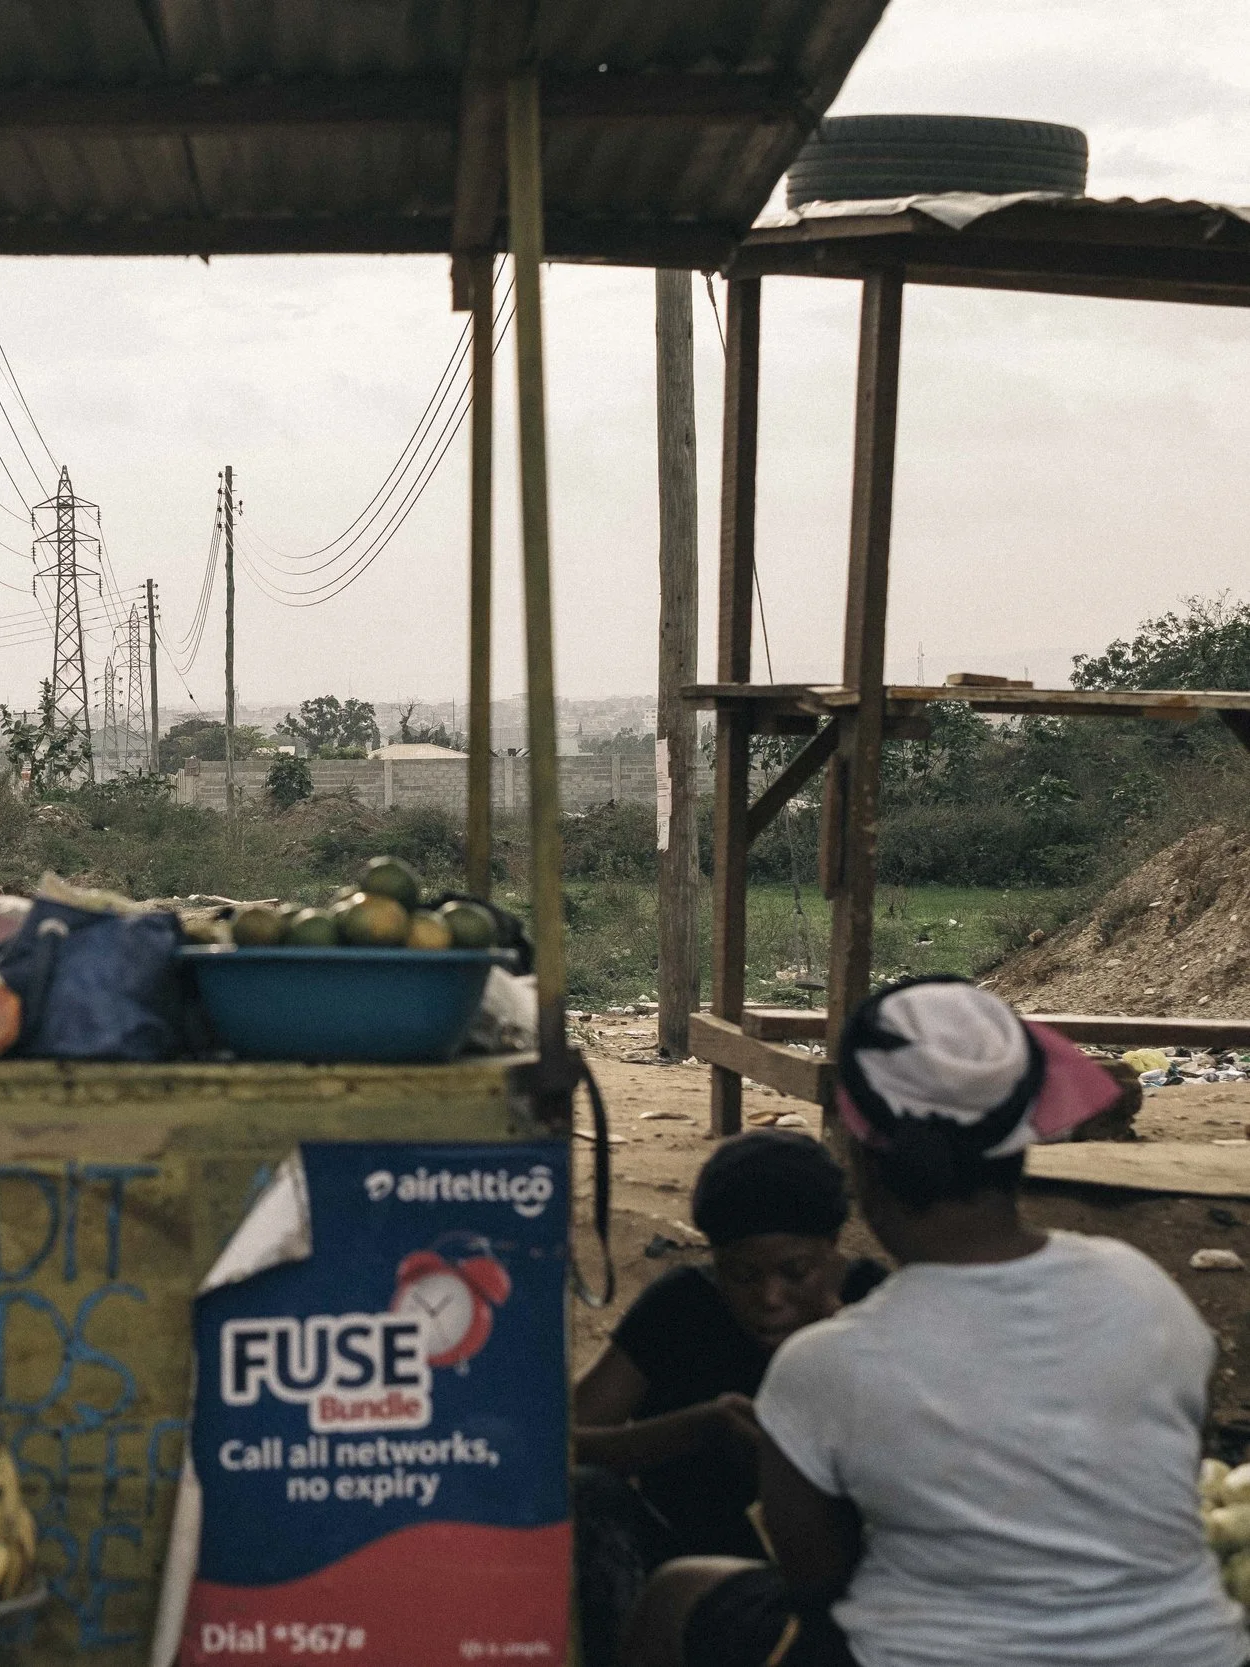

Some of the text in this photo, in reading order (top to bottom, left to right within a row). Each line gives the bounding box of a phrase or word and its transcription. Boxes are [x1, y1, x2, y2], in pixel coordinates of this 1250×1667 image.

[230, 1321, 422, 1394] FUSE
[317, 1393, 426, 1424] Bundle
[219, 1432, 500, 1471] Call all networks,
[287, 1470, 440, 1507] no expiry
[201, 1623, 267, 1654] Dial
